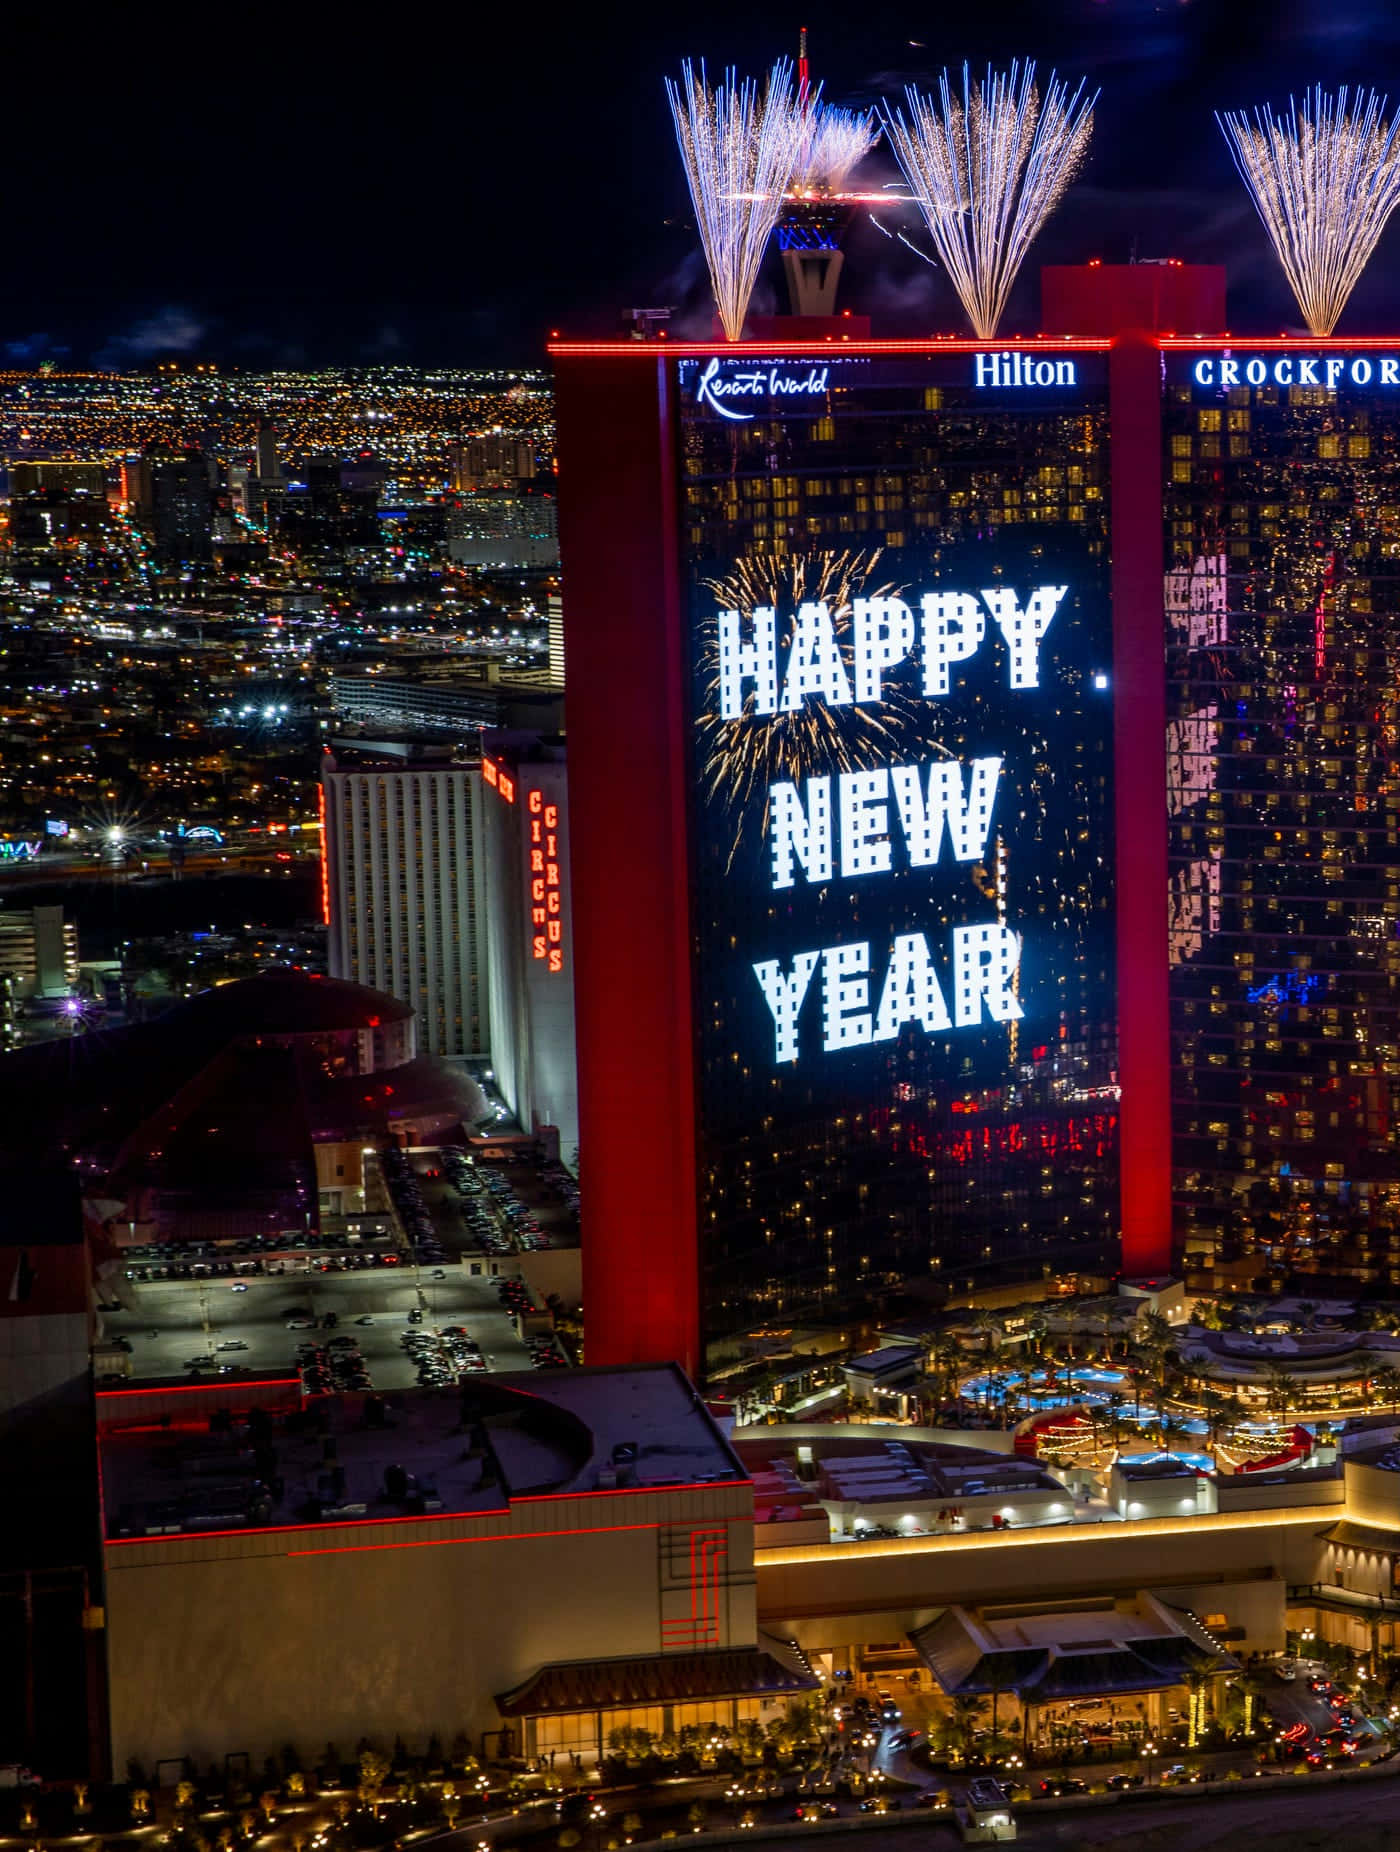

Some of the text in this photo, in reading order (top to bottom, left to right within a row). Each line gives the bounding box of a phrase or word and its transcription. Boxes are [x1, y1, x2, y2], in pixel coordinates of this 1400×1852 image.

[769, 367, 829, 396] World
[975, 351, 1077, 387] Hilton
[717, 584, 1069, 721] HAPPY
[544, 805, 563, 973] CIRCUS
[768, 756, 1002, 891] NEW
[751, 922, 1026, 1064] YEAR
